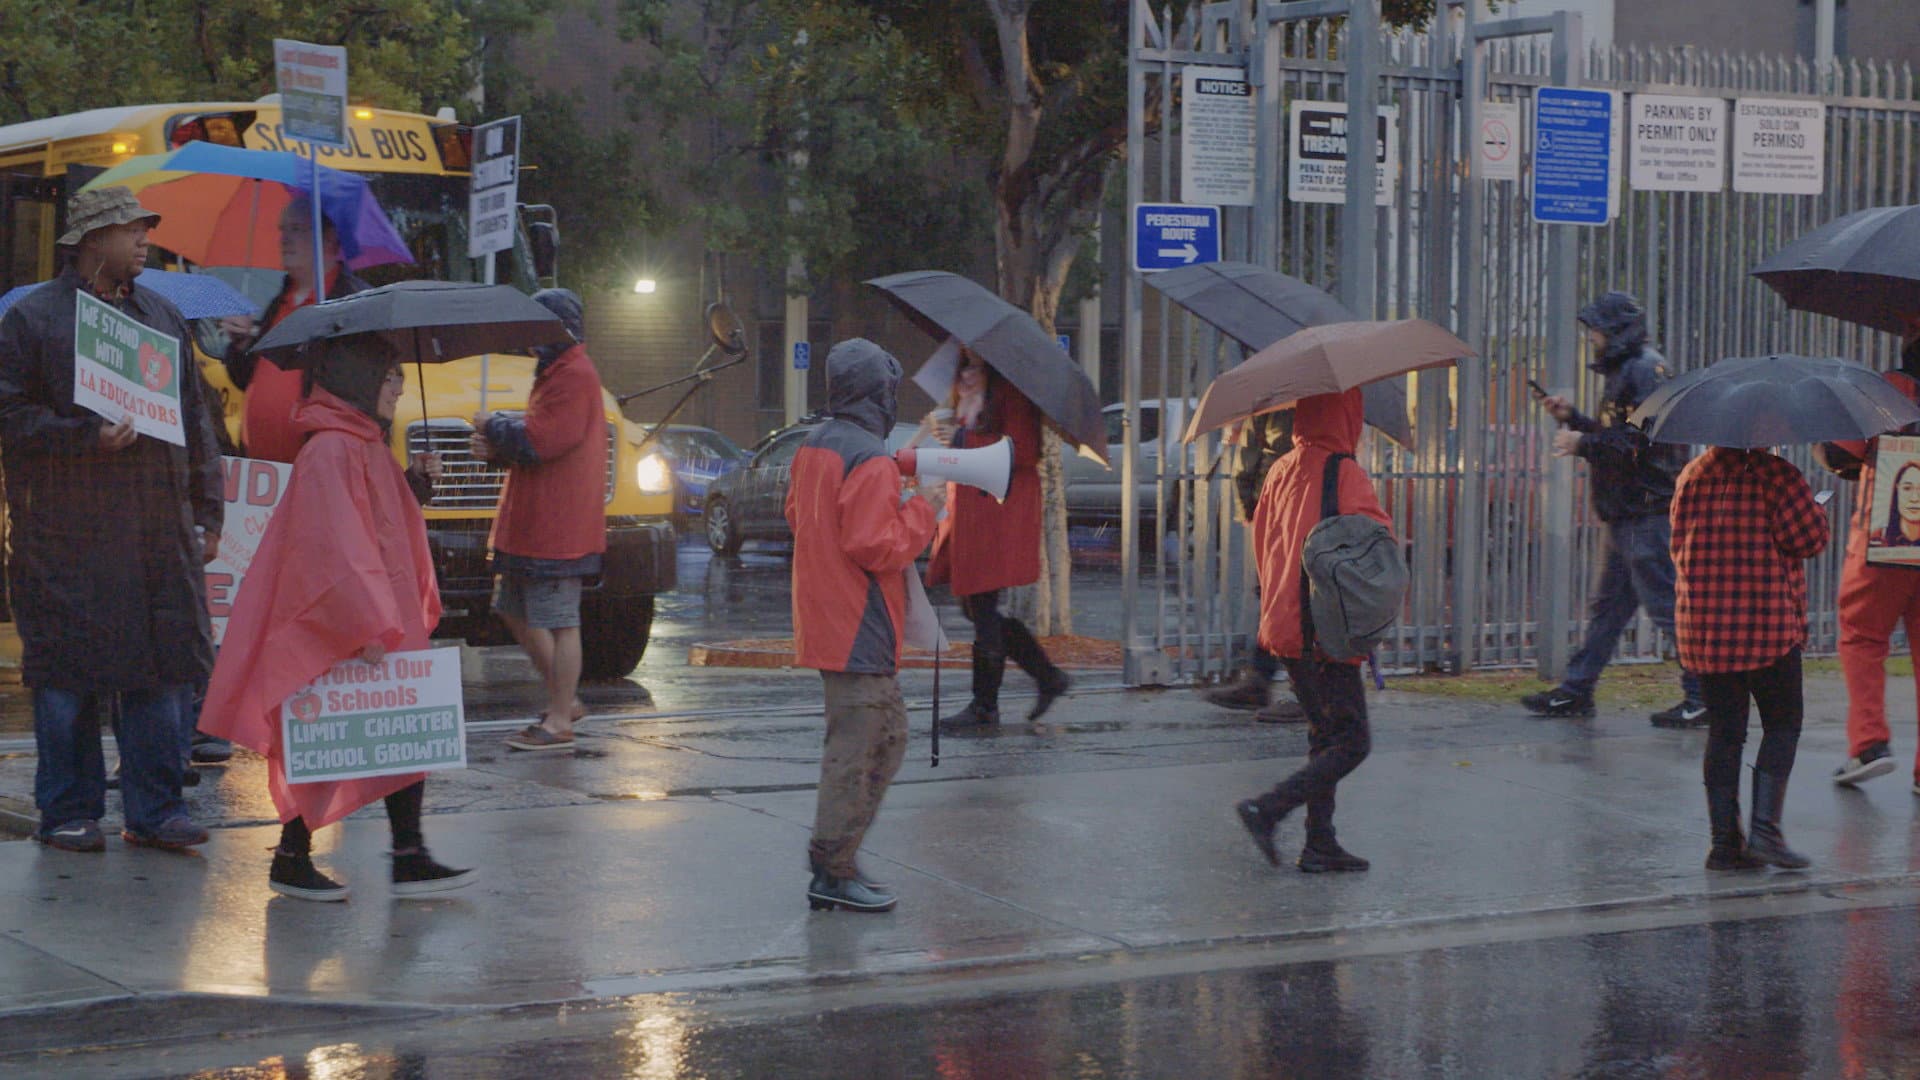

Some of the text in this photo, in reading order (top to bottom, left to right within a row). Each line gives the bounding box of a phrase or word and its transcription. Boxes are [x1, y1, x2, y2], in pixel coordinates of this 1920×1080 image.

[1200, 80, 1246, 95] NOTICE
[1645, 103, 1713, 121] PARKING BY
[1741, 103, 1819, 119] ESTACIONAMIENTO
[1330, 117, 1348, 135] N
[1638, 123, 1718, 142] PERMIT ONLY
[1784, 120, 1800, 131] CON
[255, 123, 371, 159] SCOL
[371, 127, 427, 161] BUS
[1754, 132, 1805, 149] PERMISO
[1299, 163, 1325, 174] PENAL
[1300, 174, 1323, 185] STATE
[1325, 176, 1337, 185] OF
[1145, 213, 1210, 228] PEDESTRIAN
[1161, 228, 1197, 241] ROUTE
[81, 302, 139, 350] WE STAND
[95, 338, 124, 370] WITH
[80, 368, 96, 393] LA
[99, 378, 178, 426] EDUCATORS
[322, 658, 433, 687] rotect Our
[327, 684, 418, 713] Schools
[293, 710, 454, 744] LIMIT CHARTER
[291, 737, 461, 772] SCHOOL GROWTH
